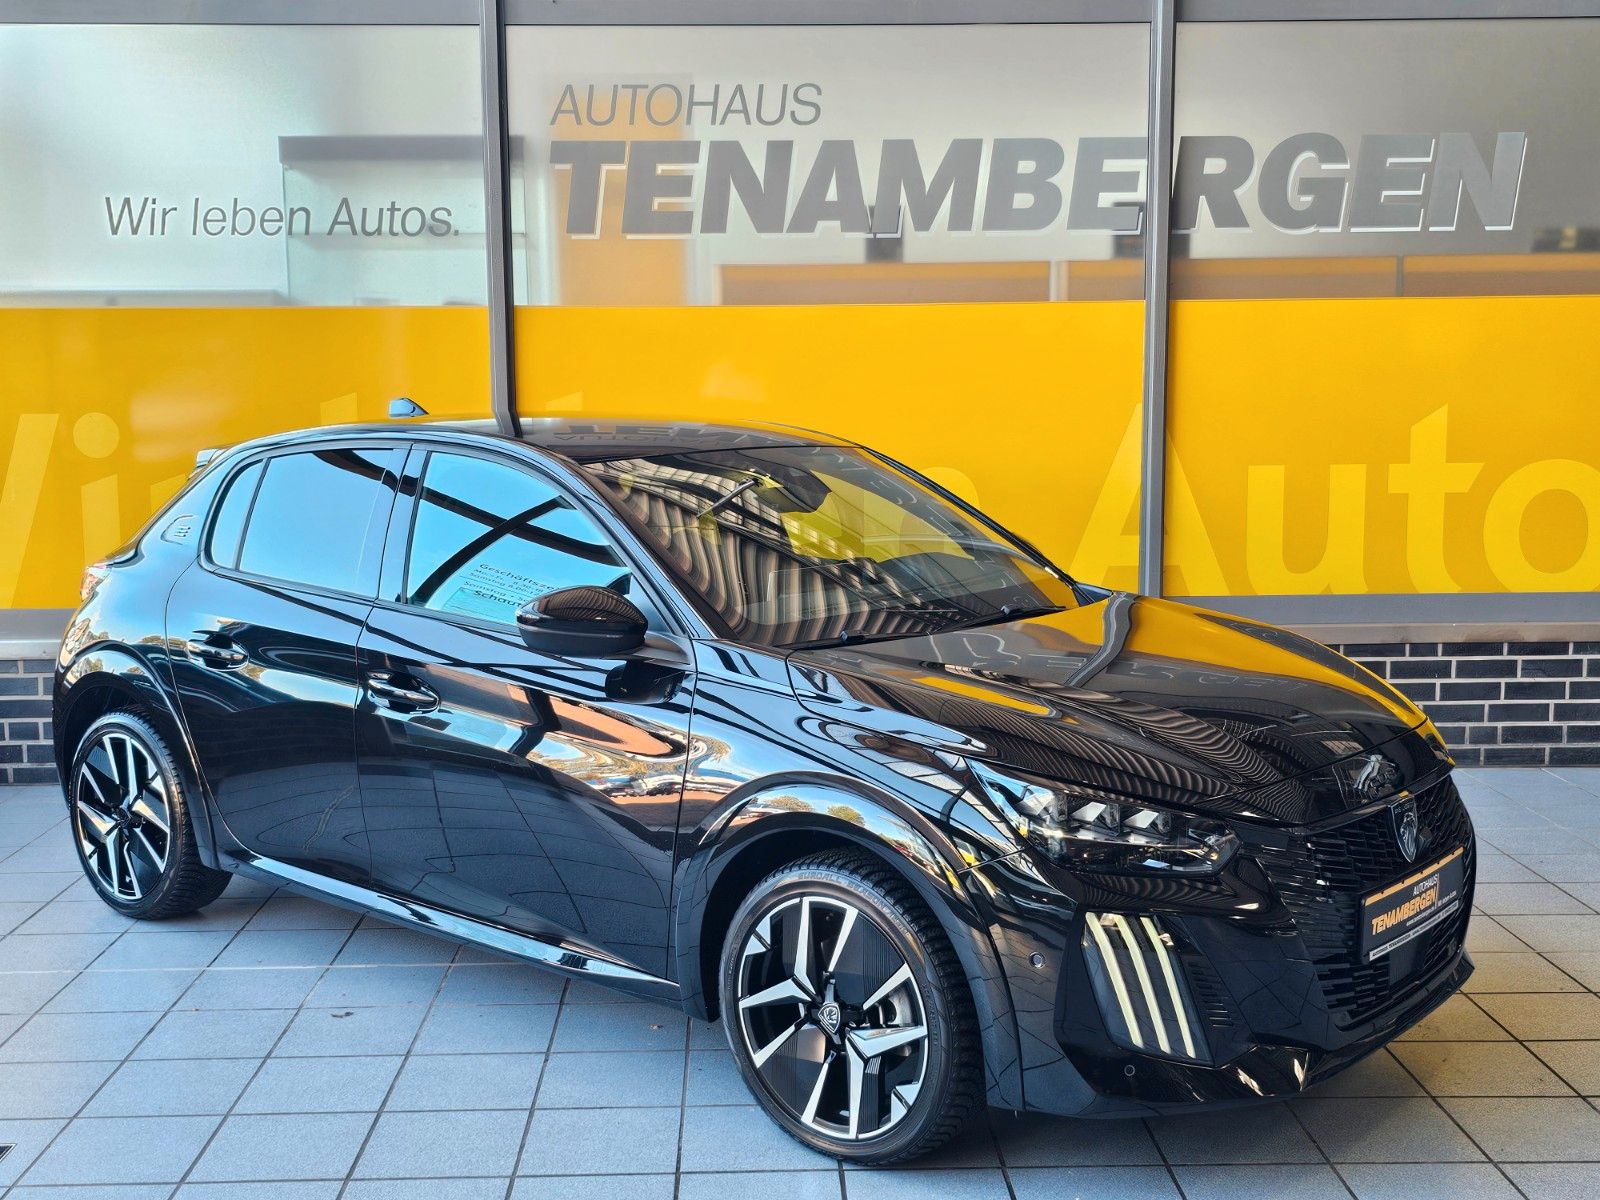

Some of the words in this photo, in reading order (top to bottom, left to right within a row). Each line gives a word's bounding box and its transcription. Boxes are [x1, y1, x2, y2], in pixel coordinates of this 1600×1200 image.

[550, 82, 823, 126] AUTOHAUS
[550, 131, 1527, 239] TENAMBERGEN
[104, 196, 178, 236] Wir
[191, 197, 312, 237] leben
[326, 197, 460, 238] Autos.
[1371, 886, 1437, 936] TENAMBERGEN
